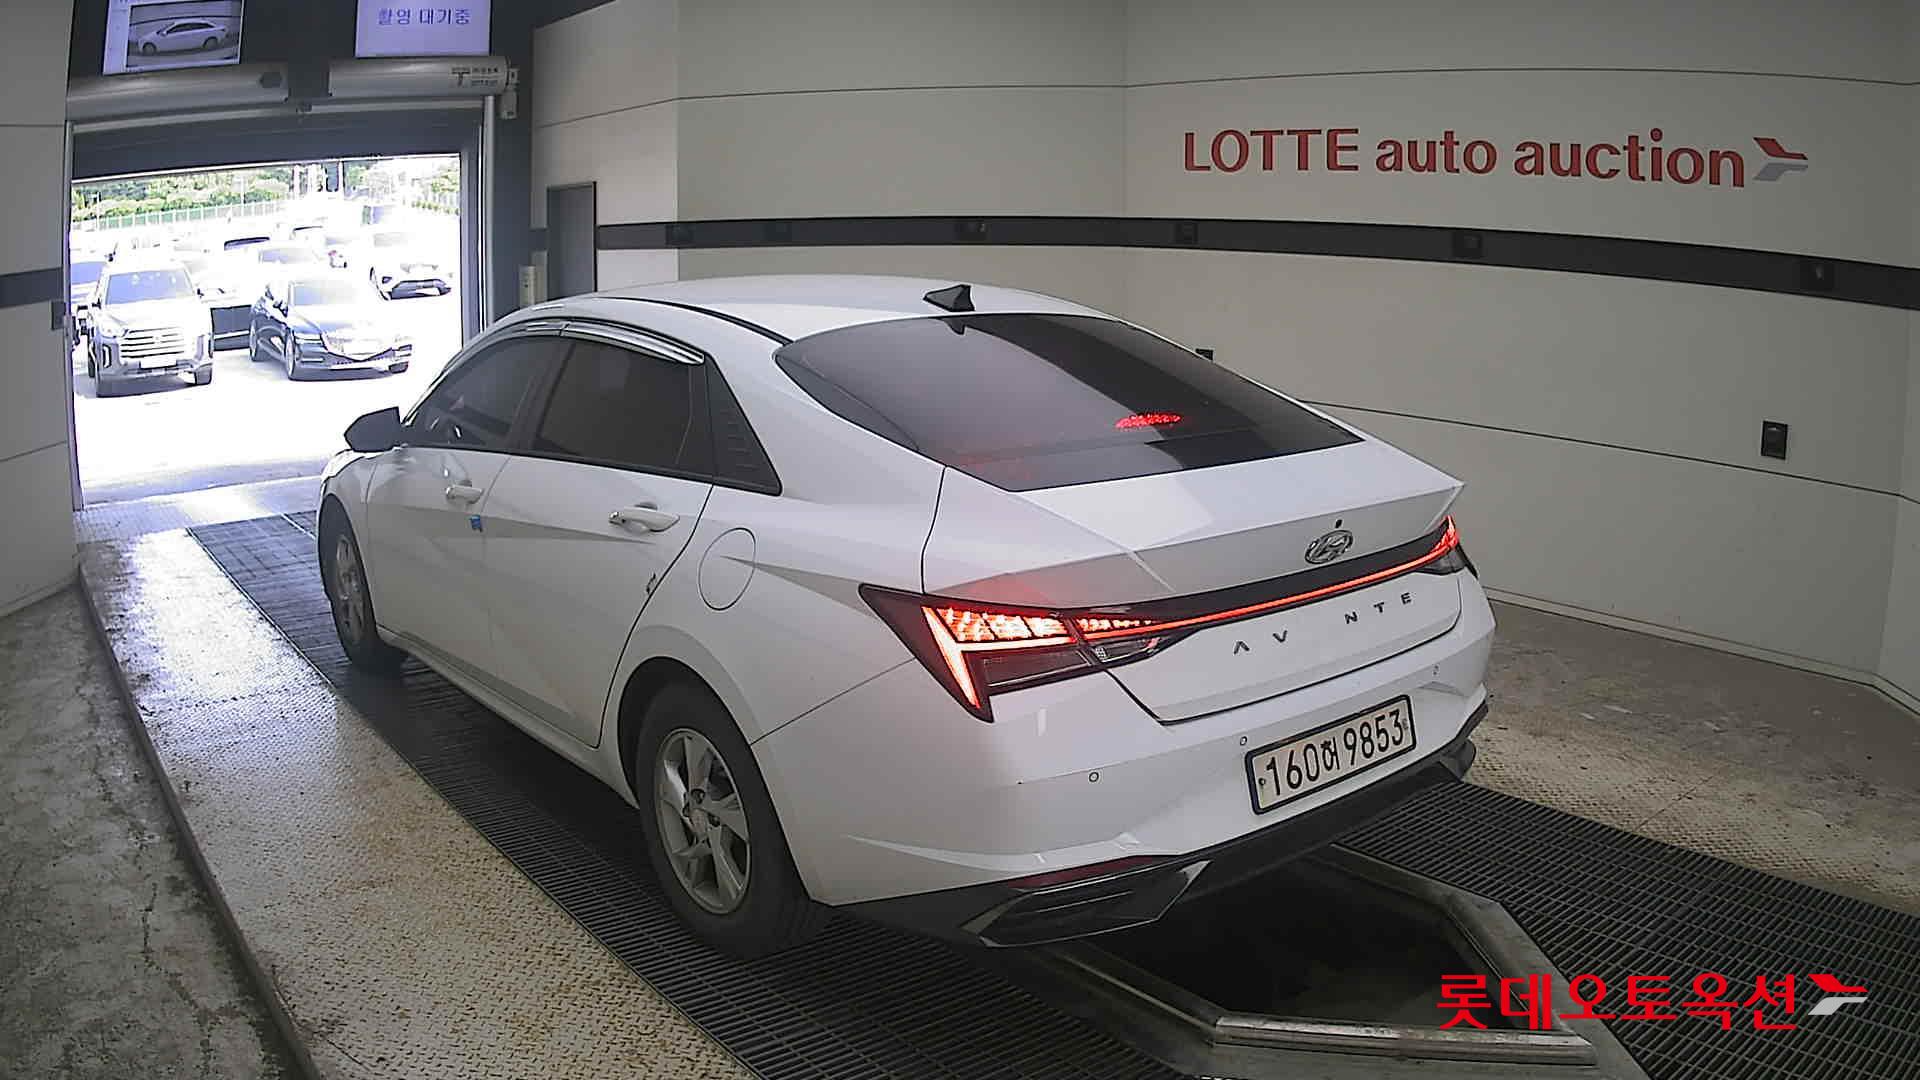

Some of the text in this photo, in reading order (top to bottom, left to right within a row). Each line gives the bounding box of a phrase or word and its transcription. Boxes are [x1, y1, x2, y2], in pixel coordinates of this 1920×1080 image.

[419, 8, 470, 25] 대기중
[1184, 128, 1745, 188] LOTTE auto auction
